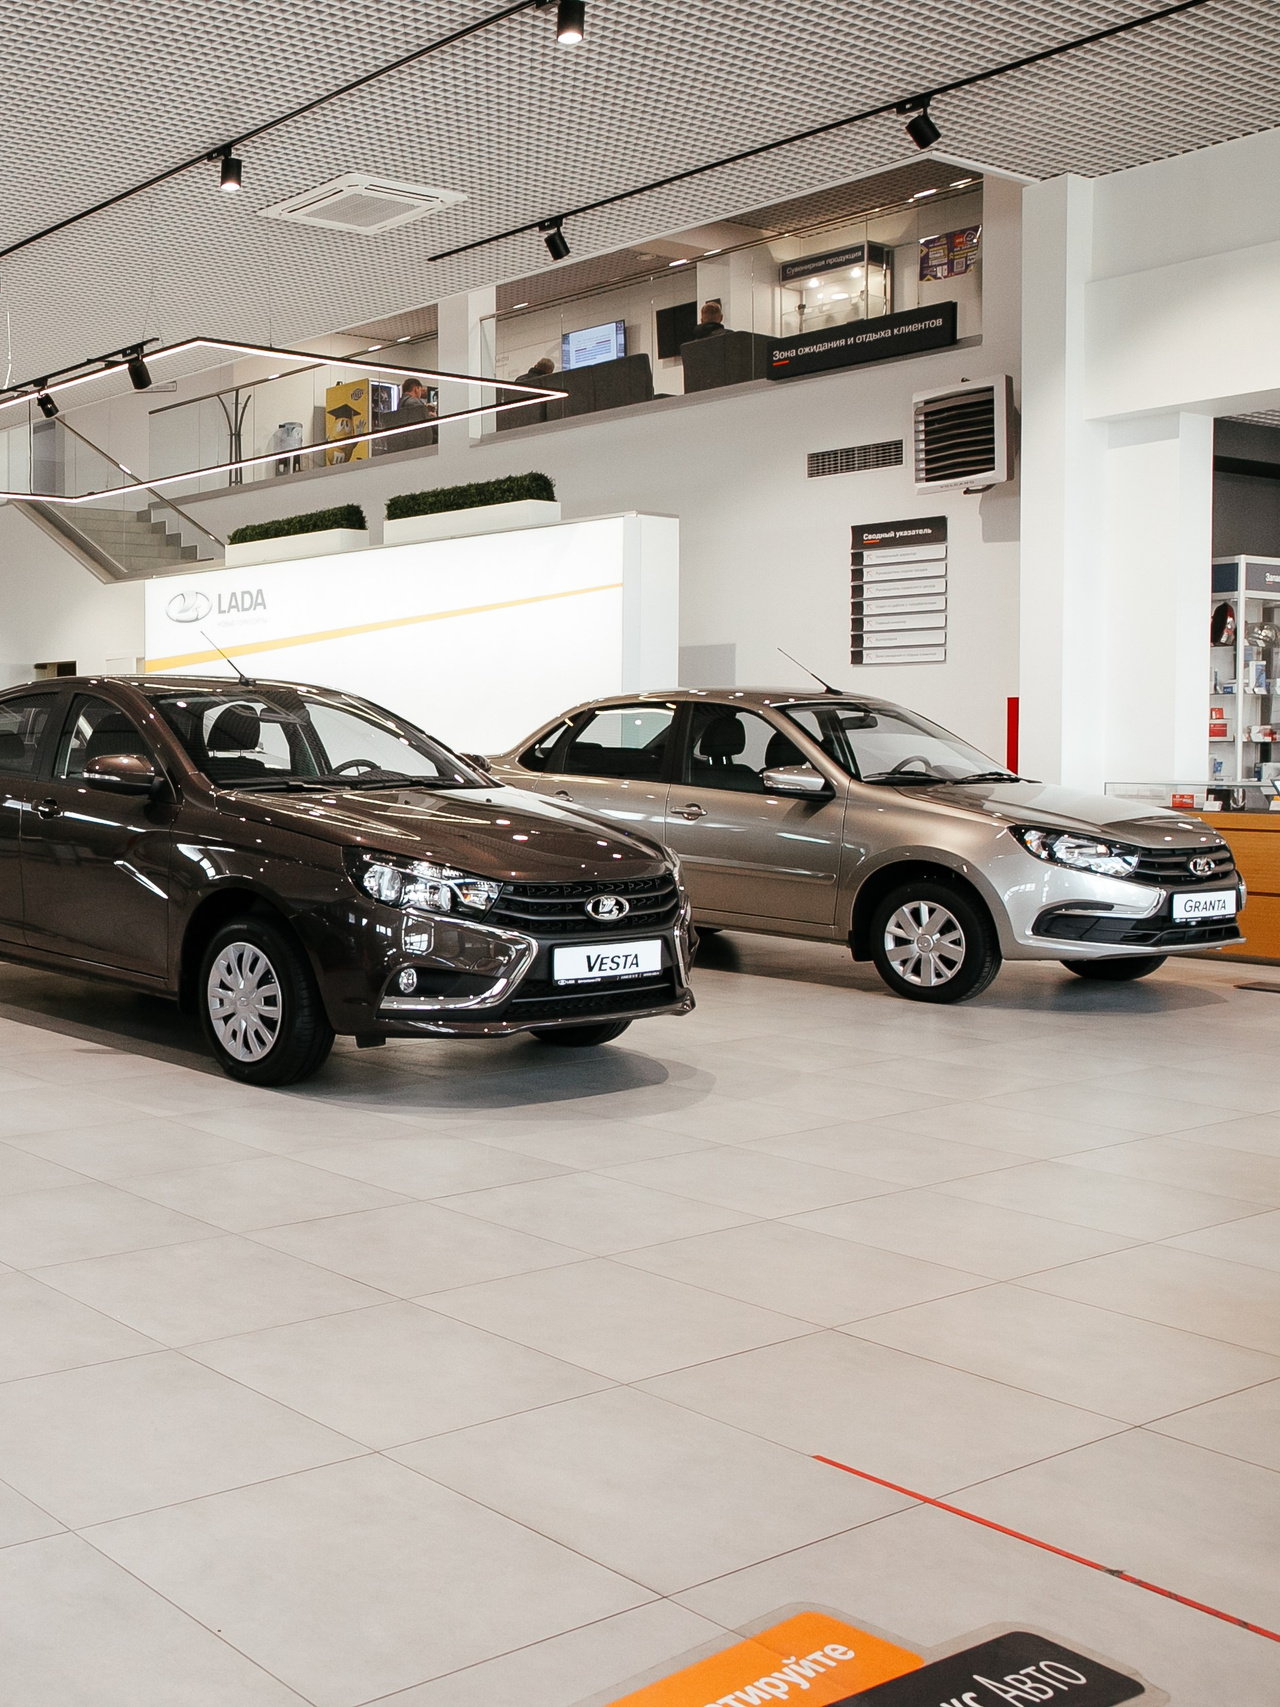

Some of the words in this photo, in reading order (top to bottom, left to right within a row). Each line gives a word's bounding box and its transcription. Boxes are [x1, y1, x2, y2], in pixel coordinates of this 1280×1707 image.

[786, 260, 825, 275] Сувенирная
[825, 251, 862, 265] продукция
[772, 346, 796, 361] Зона
[797, 338, 846, 356] ожидания
[847, 336, 854, 345] и
[855, 330, 892, 343] отдыха
[893, 318, 943, 335] клиентов
[863, 530, 895, 540] Сводный
[895, 528, 932, 538] указатель
[217, 588, 267, 614] LADA
[1183, 898, 1227, 913] GRANTA
[585, 953, 640, 973] VESTA
